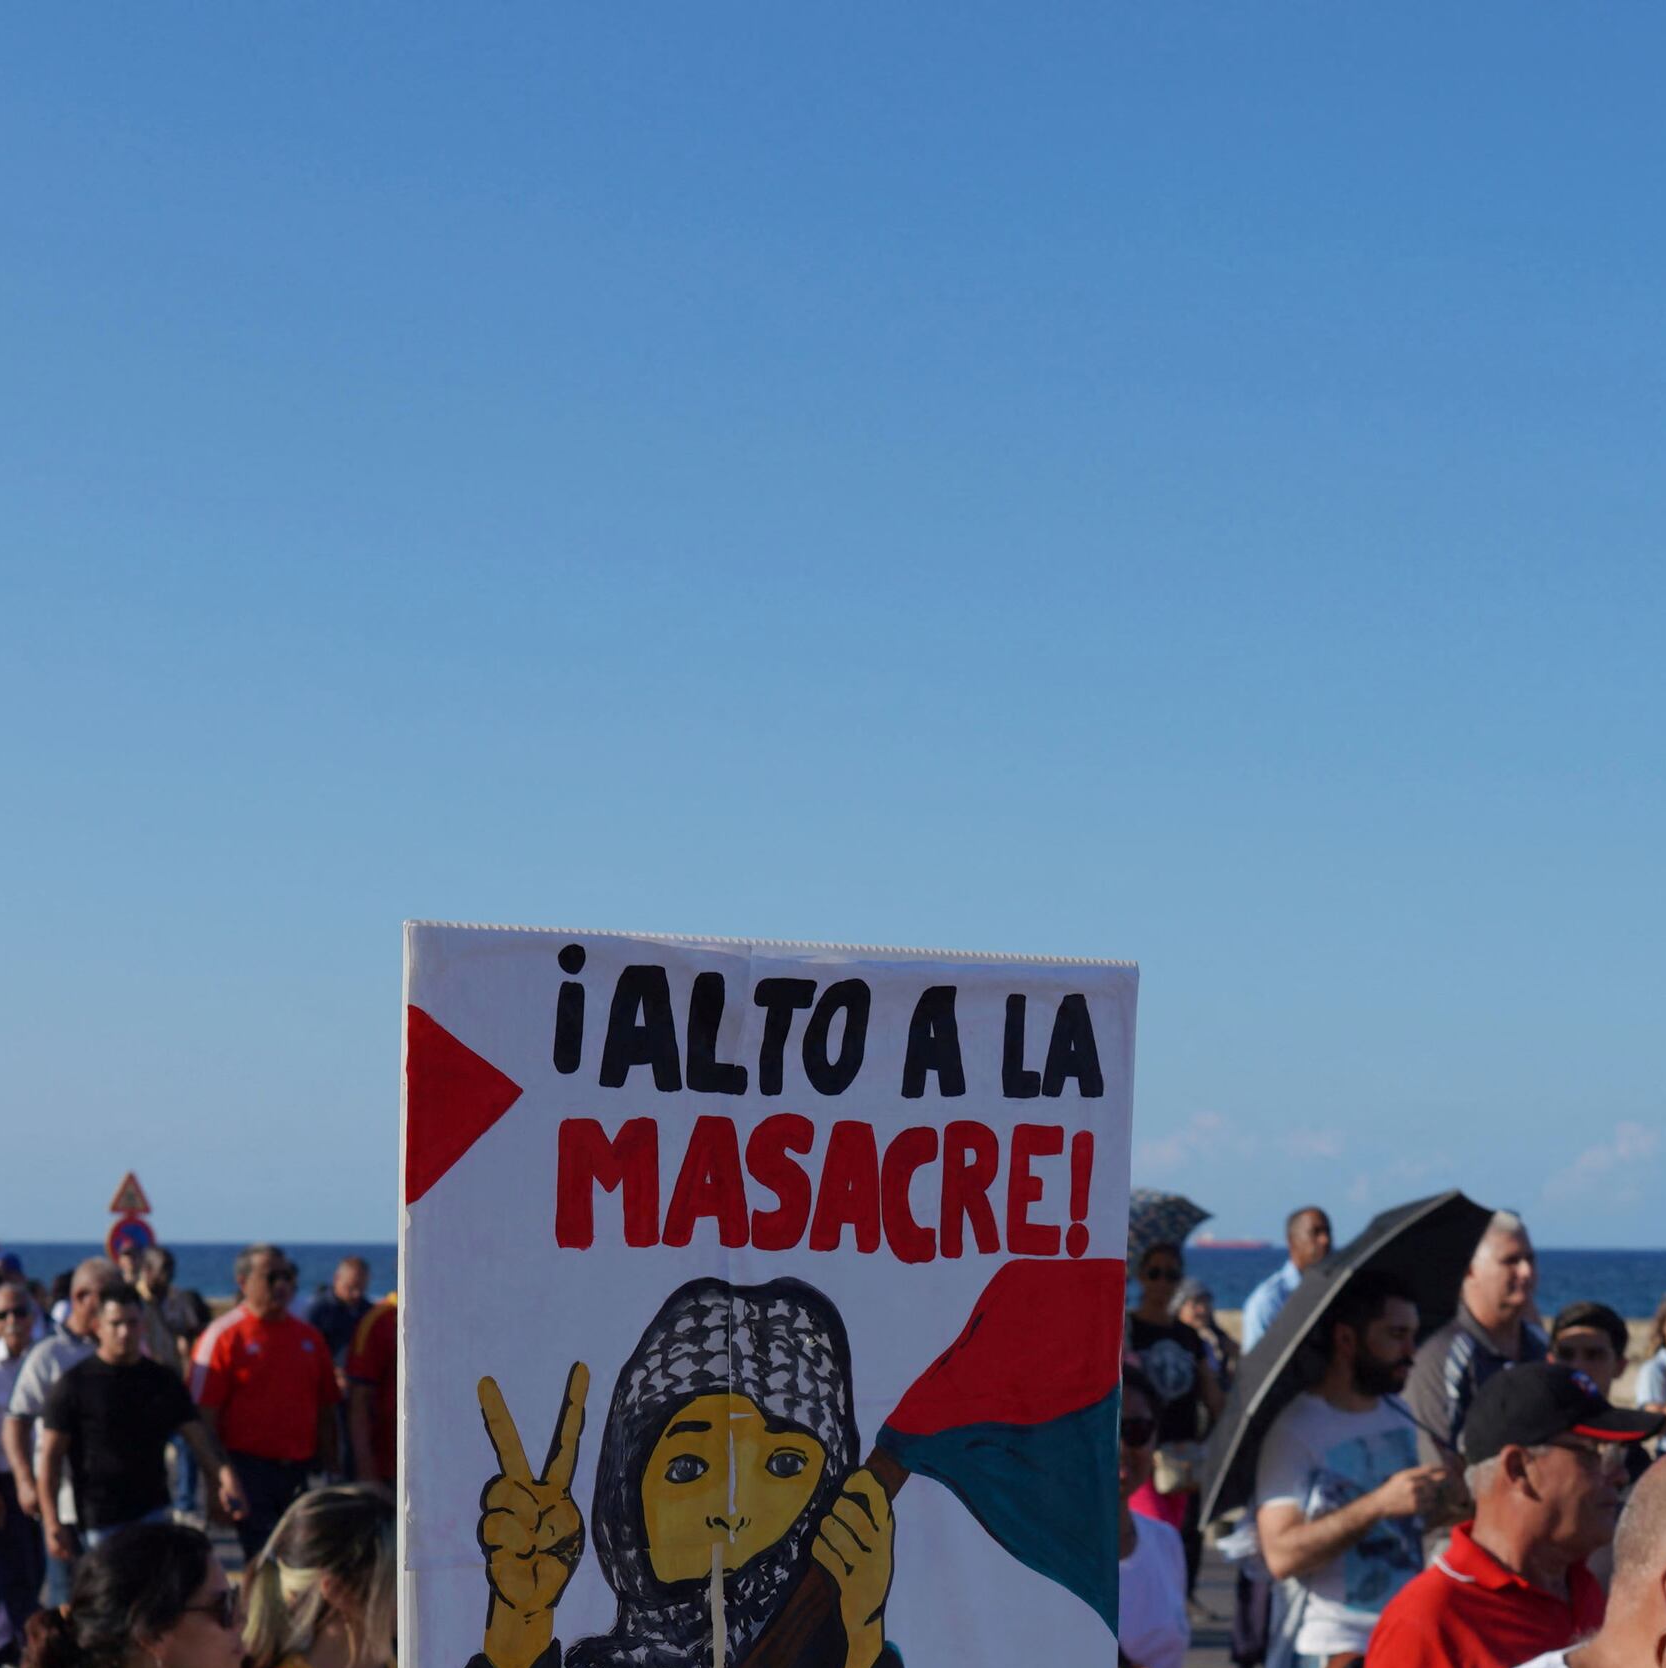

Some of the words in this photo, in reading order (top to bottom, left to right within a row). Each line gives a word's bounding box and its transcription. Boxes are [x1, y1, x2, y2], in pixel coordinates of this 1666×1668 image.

[553, 944, 871, 1096] ¡ALTO
[901, 985, 966, 1098] A
[1002, 993, 1104, 1098] LA
[554, 1112, 1094, 1264] MASACRE!
